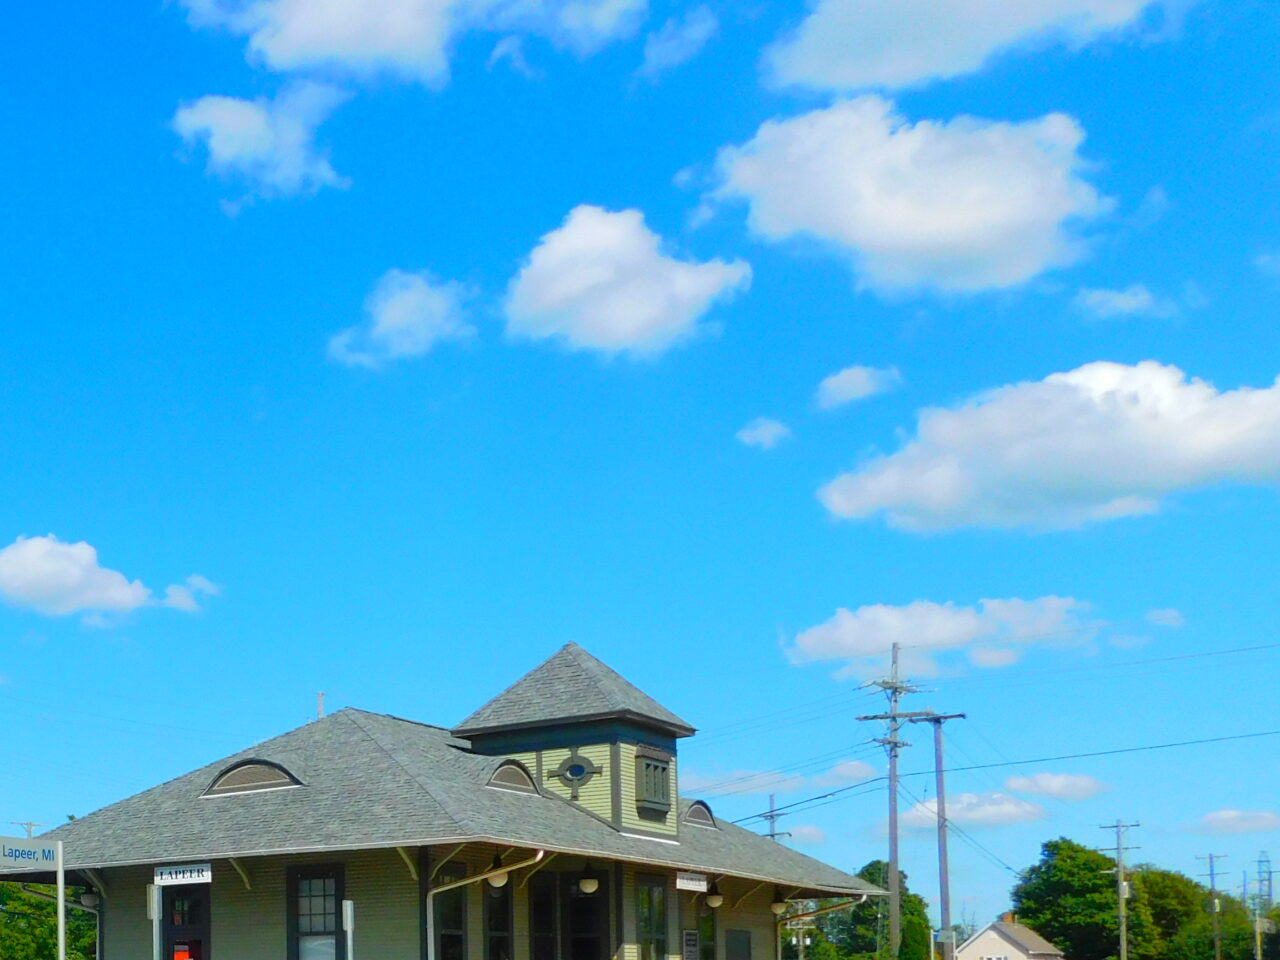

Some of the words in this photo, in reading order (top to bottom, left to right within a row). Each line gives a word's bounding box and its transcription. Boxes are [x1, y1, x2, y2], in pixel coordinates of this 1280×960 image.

[2, 844, 39, 861] Lapeer,
[41, 848, 55, 861] MI
[159, 868, 205, 880] LAPEER
